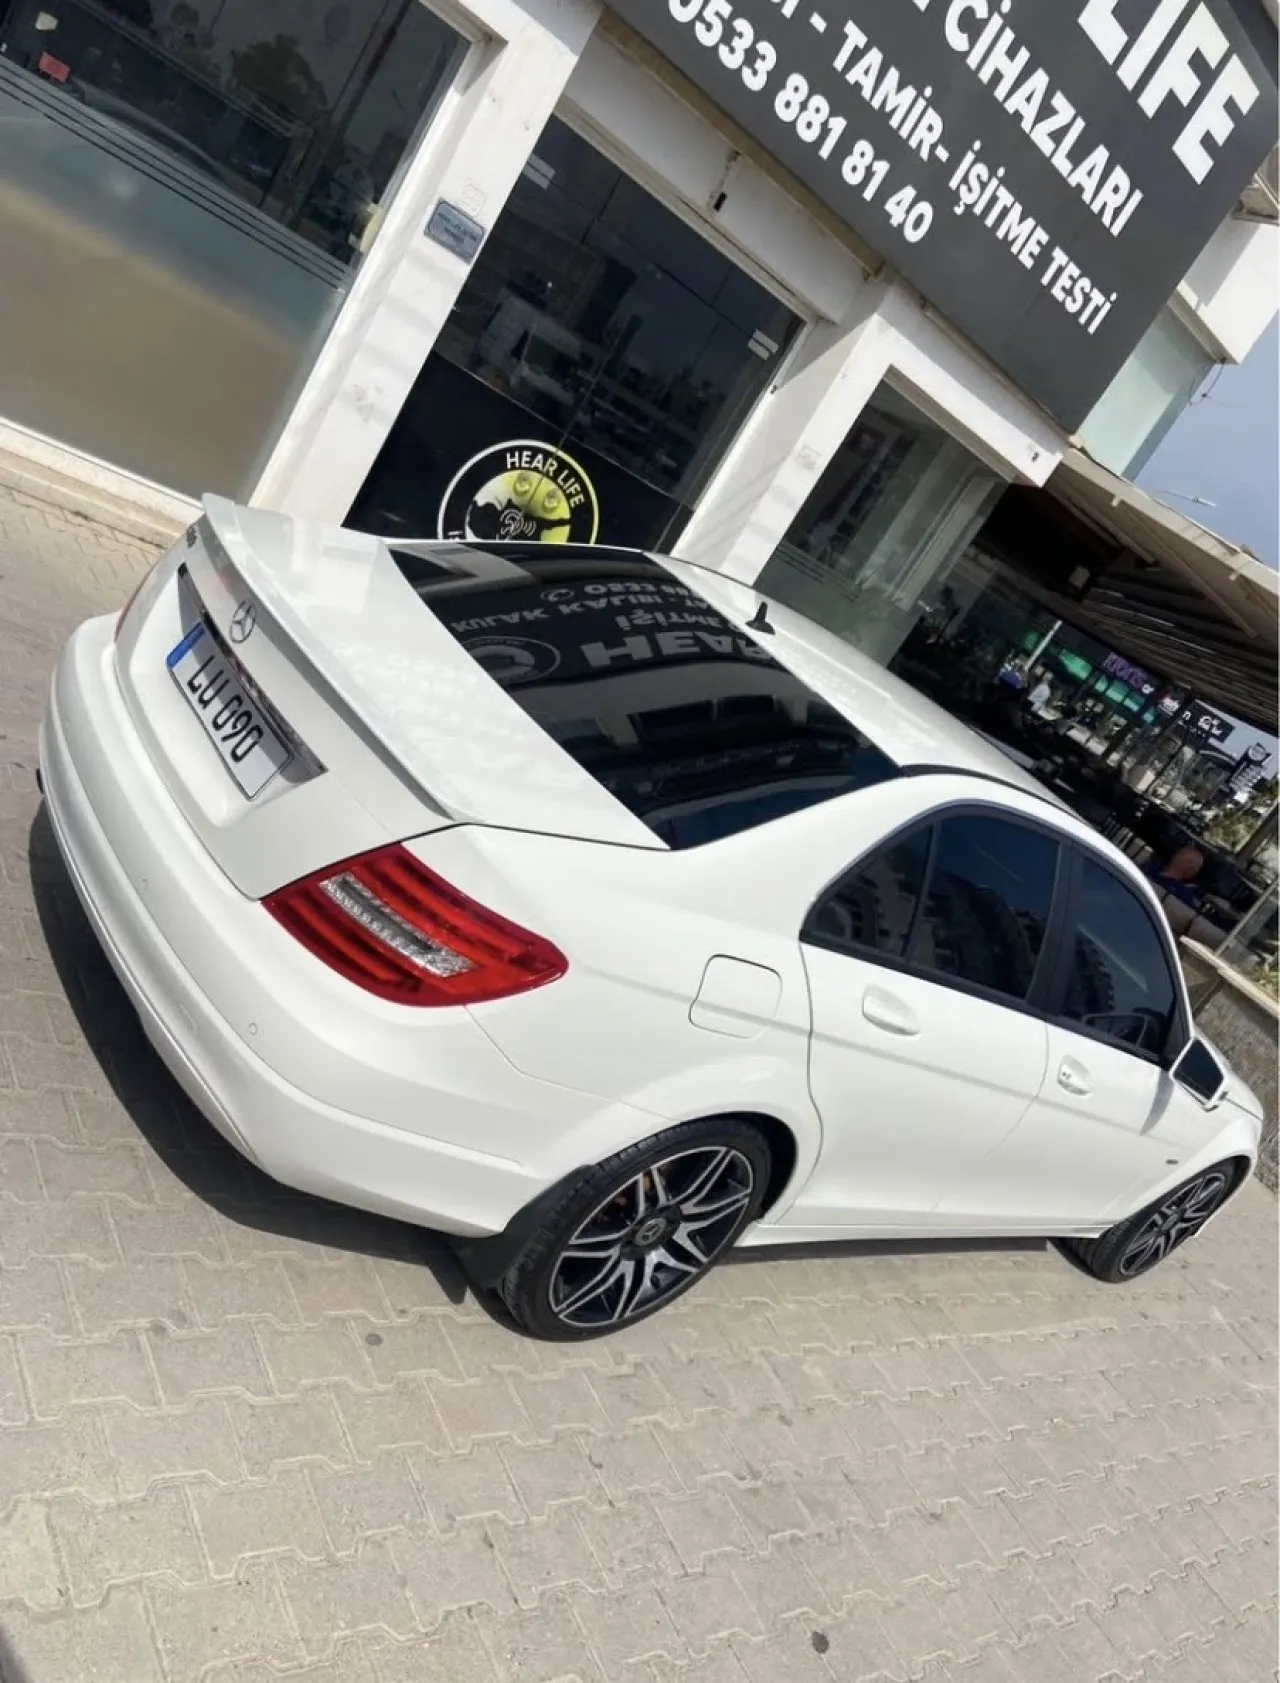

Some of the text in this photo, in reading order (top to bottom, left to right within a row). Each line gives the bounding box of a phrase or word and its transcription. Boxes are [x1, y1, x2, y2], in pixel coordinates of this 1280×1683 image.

[773, 72, 848, 160] 881
[841, 139, 891, 202] 81
[883, 184, 934, 244] 40
[944, 0, 1144, 237] CİHAZLARI
[948, 139, 1050, 270] İŞİTME
[1040, 246, 1117, 336] TESTİ
[506, 450, 586, 508] HEAR LIFE
[187, 654, 265, 763] LU 090
